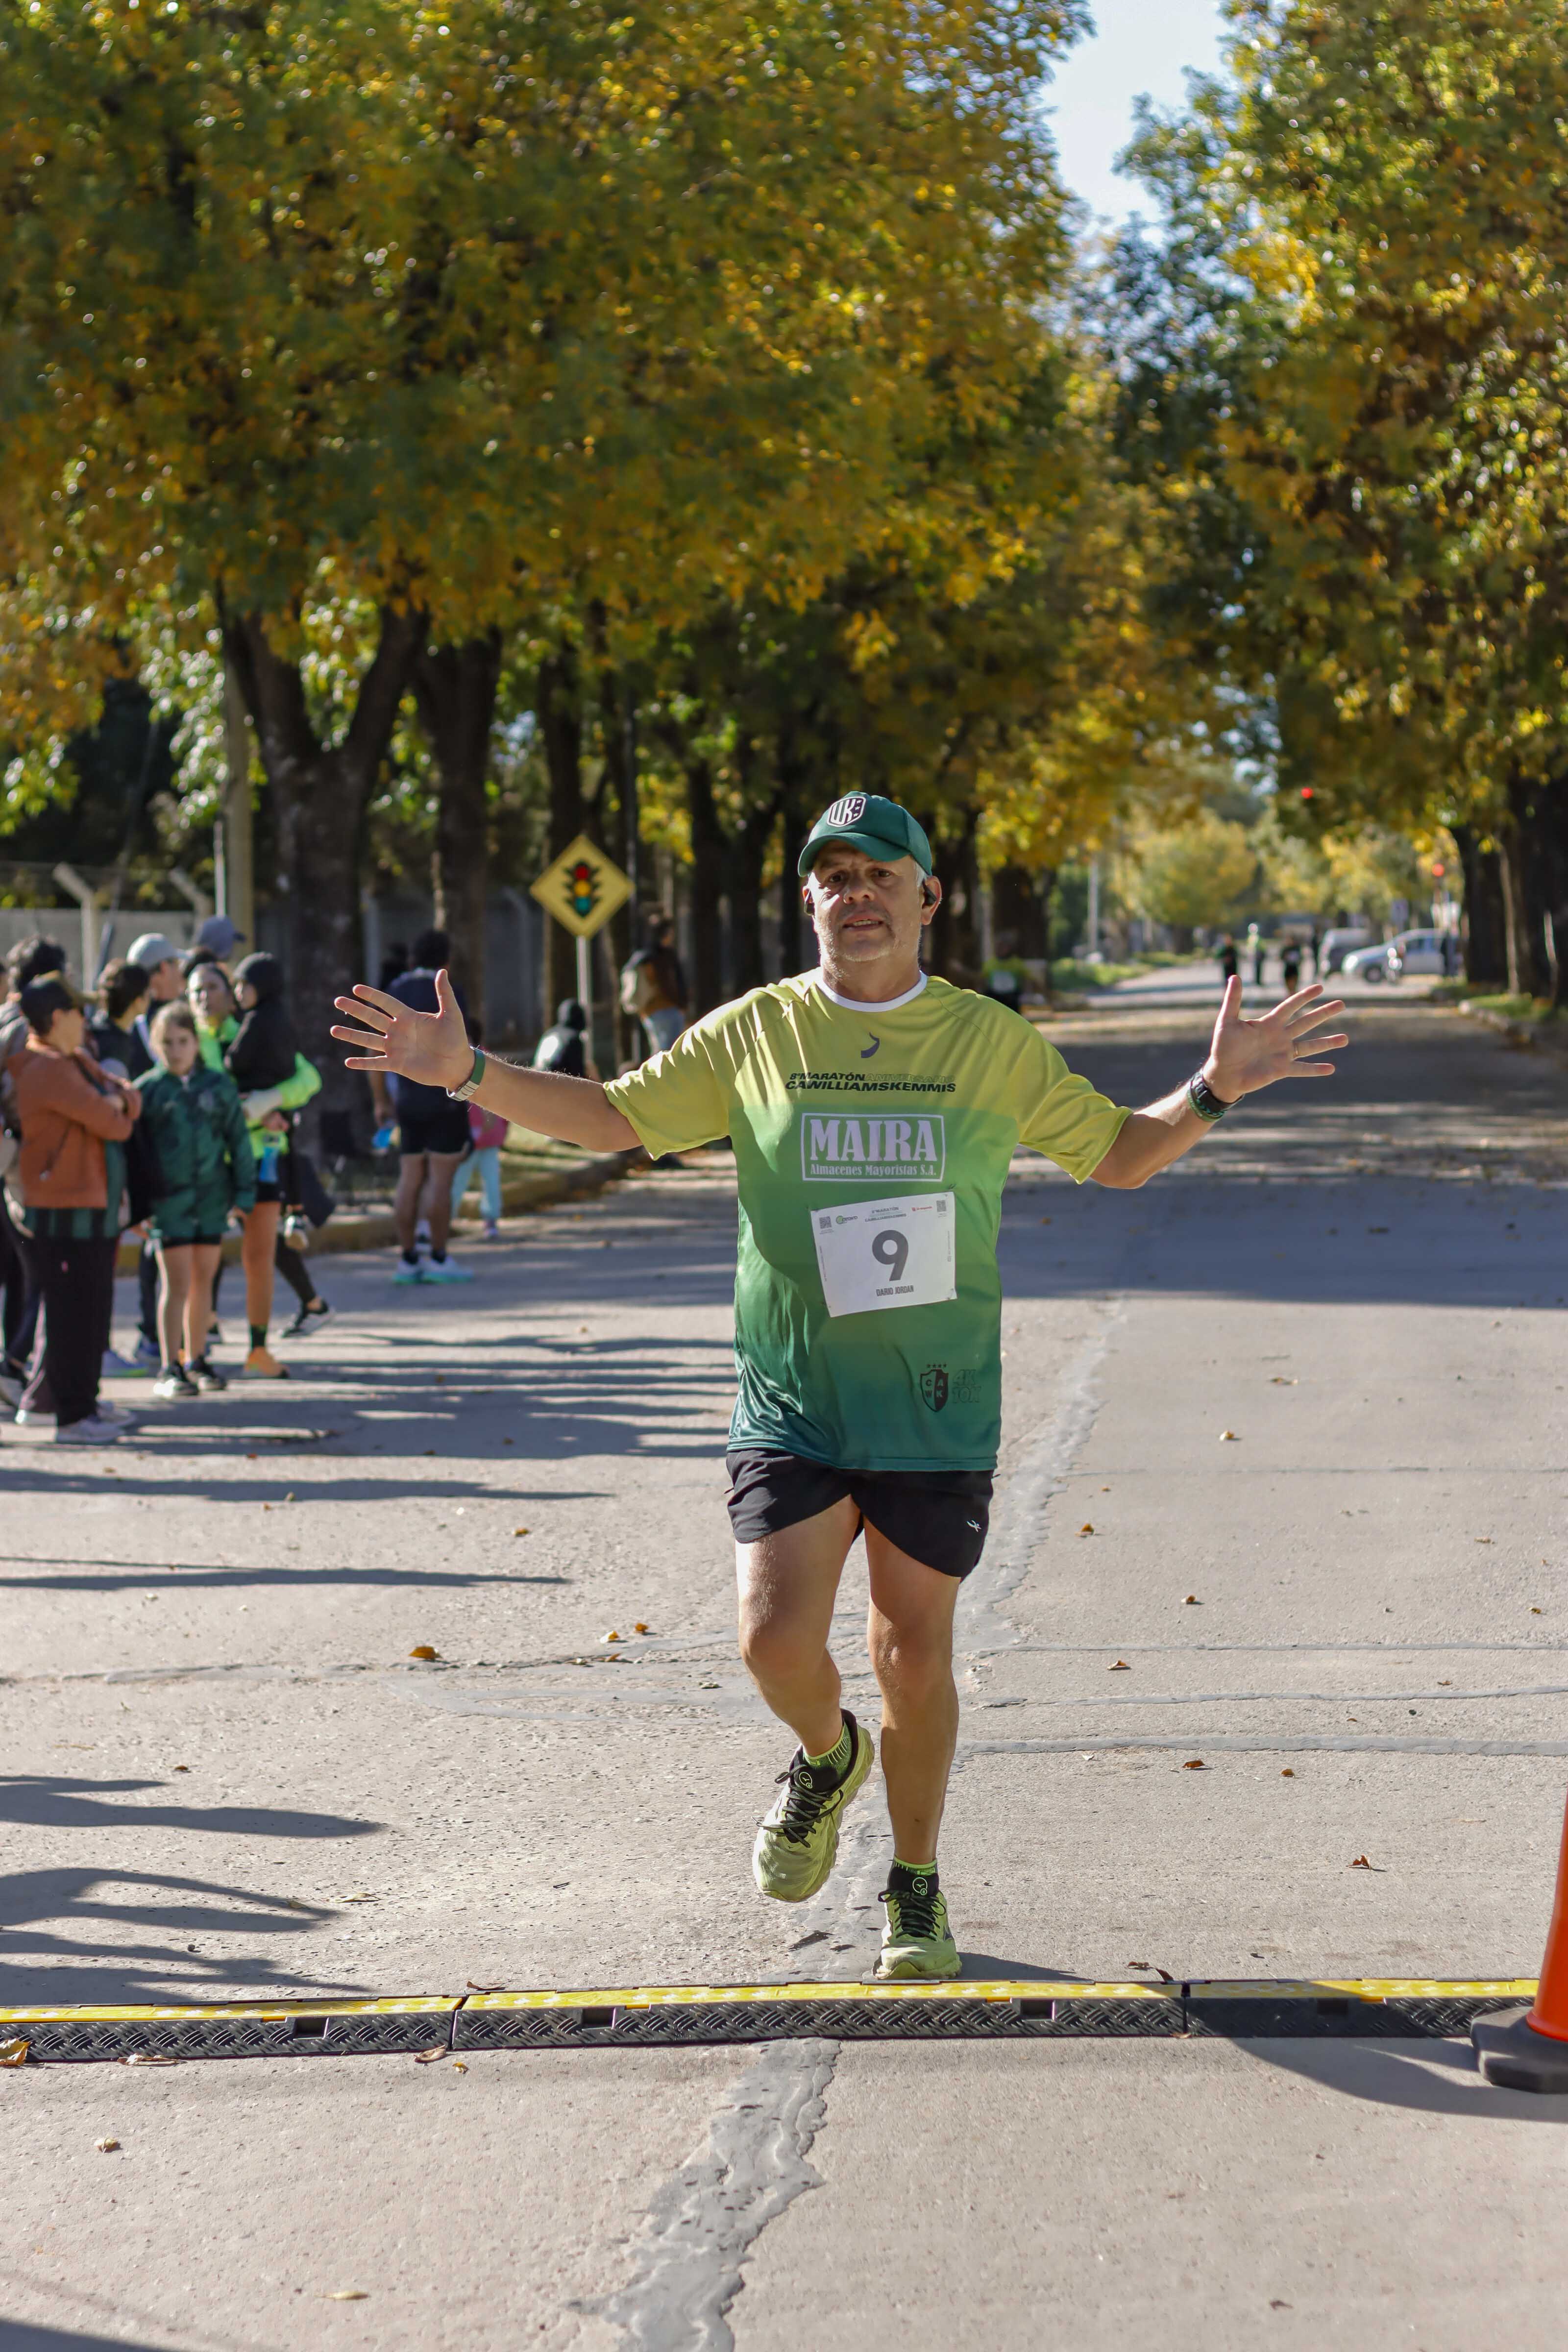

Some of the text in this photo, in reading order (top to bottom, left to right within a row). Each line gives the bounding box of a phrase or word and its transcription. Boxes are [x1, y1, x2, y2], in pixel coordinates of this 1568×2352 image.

[785, 1080, 956, 1093] CAWILLIAMSKEMMIS
[810, 1119, 937, 1161] MAIRA
[810, 1164, 936, 1176] Almacenes Mayoristas S.A.
[872, 1230, 908, 1281] 9
[876, 1285, 914, 1297] DARIO JORDAN
